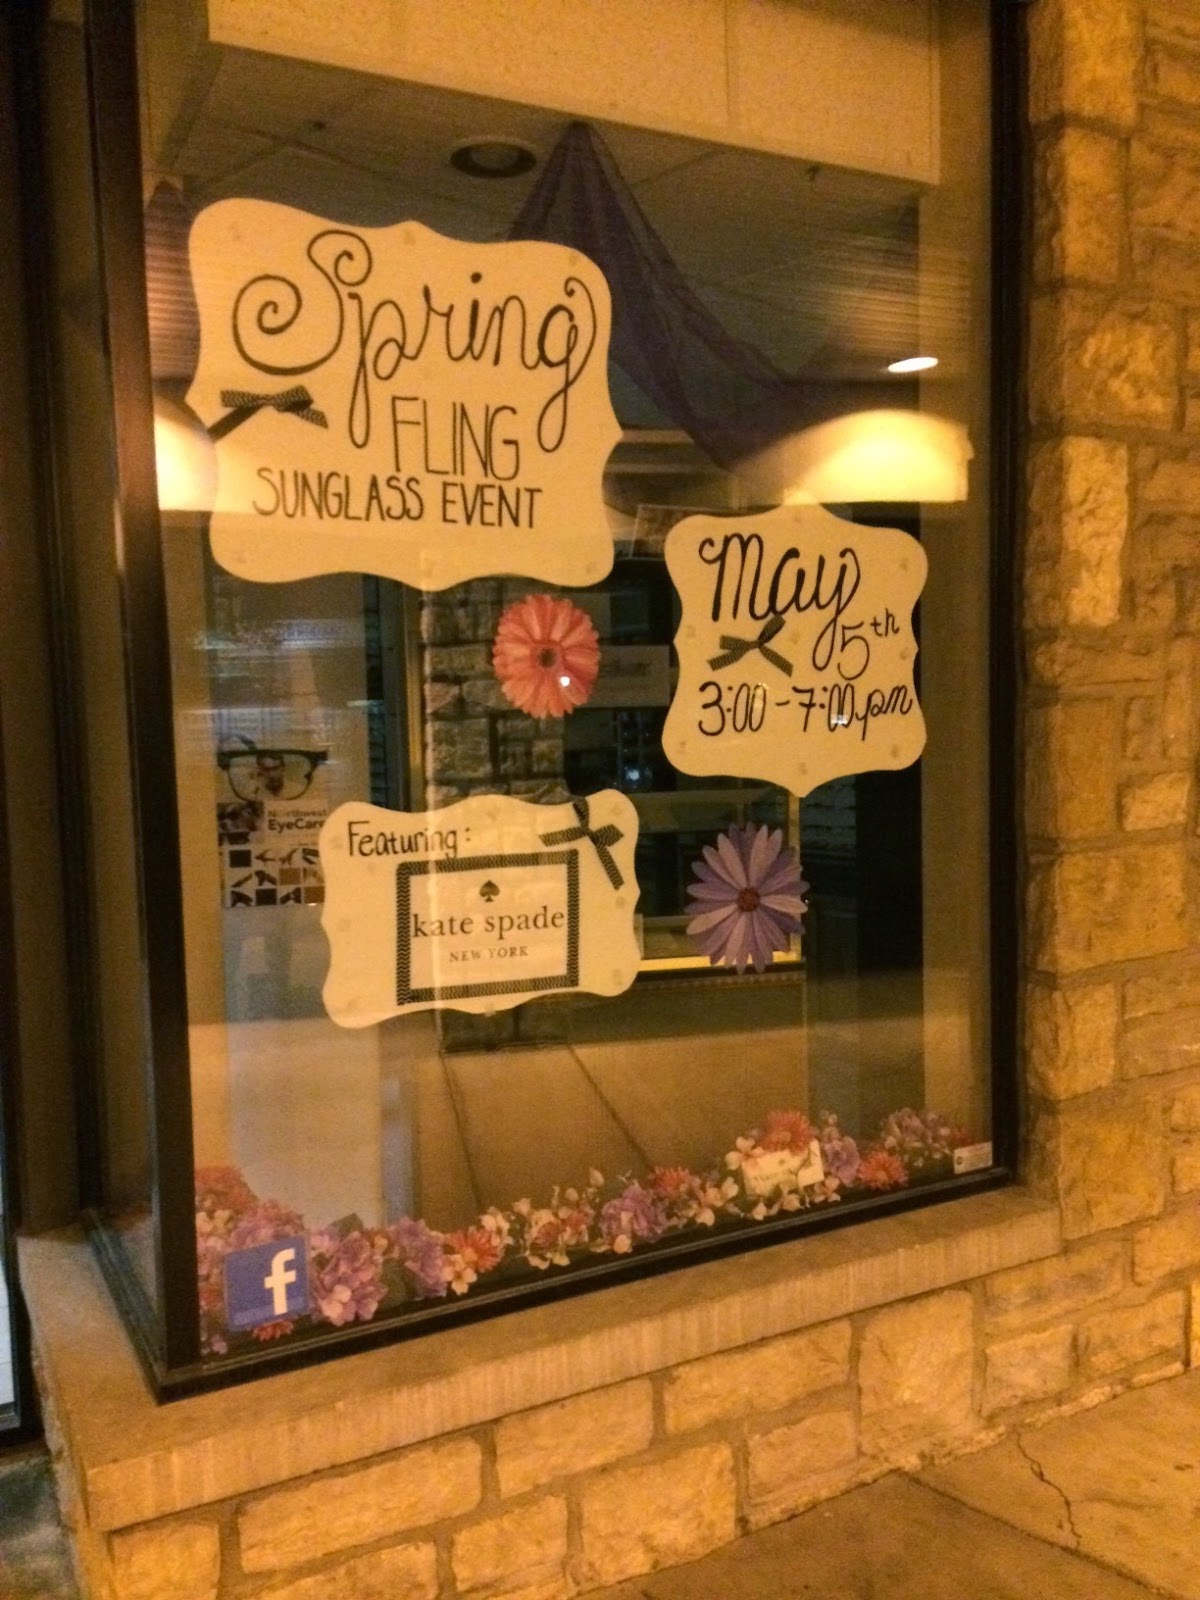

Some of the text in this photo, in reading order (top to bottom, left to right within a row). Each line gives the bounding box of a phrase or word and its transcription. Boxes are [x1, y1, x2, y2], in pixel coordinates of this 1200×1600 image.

[232, 229, 597, 453] Spring
[392, 396, 520, 481] FLING
[252, 467, 543, 529] SUNGLASS EVENT
[698, 532, 861, 671] May
[837, 608, 900, 680] 5th
[268, 809, 327, 818] Nrthwest
[412, 904, 565, 940] kate spade
[449, 945, 529, 962] NEW YORK
